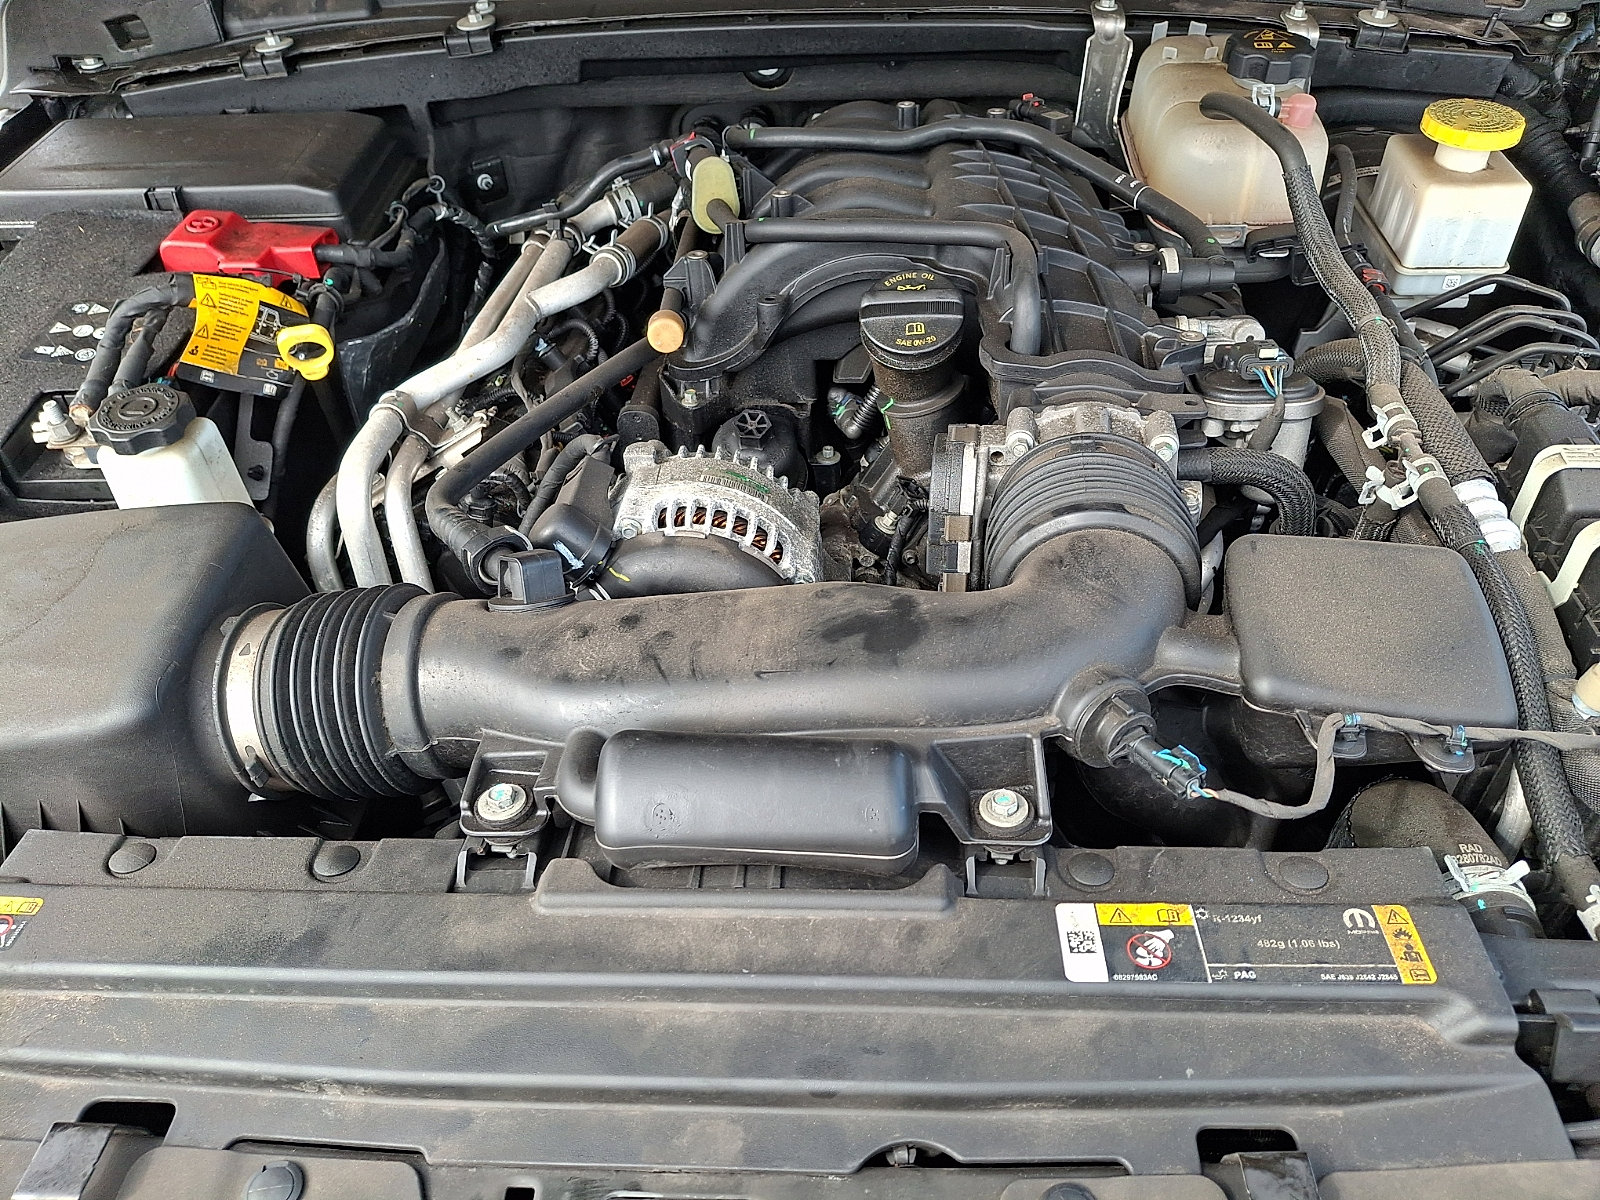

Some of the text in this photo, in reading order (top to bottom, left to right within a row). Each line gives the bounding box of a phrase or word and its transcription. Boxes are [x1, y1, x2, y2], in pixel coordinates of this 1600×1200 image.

[883, 272, 935, 288] ENGINE OIL
[895, 338, 912, 347] SAE
[1459, 844, 1483, 853] RAD
[1318, 939, 1341, 949] lbs)
[1234, 970, 1257, 979] PAG
